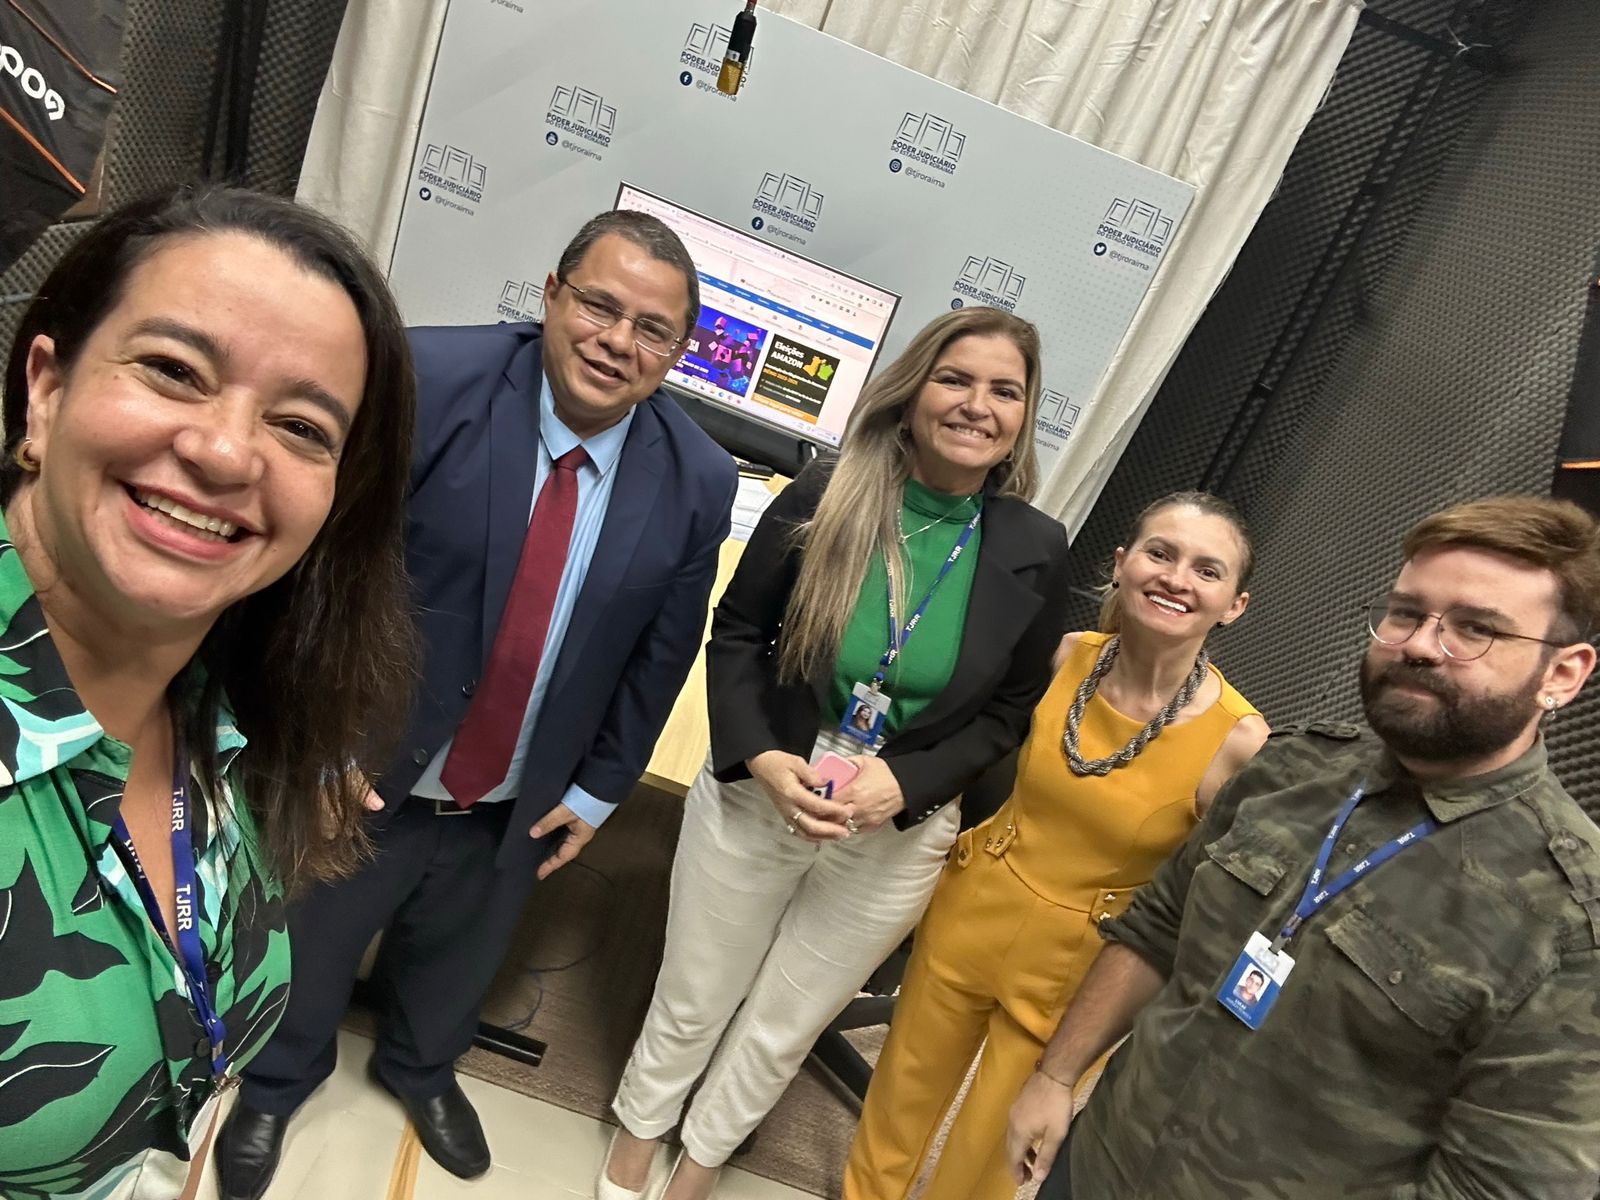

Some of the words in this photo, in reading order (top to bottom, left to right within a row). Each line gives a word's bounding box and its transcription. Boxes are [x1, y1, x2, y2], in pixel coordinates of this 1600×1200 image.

[681, 52, 706, 66] PODER
[690, 62, 710, 73] ESTADO
[547, 113, 570, 126] PODER
[572, 124, 611, 143] JUDICIÁRIO
[555, 123, 575, 133] ESTADO
[585, 135, 608, 147] RORAIMA
[562, 140, 602, 161] @tjroraima
[893, 140, 916, 153] PODER
[917, 150, 956, 170] JUDICIÁRIO
[900, 150, 920, 161] ESTADO
[929, 162, 954, 175] RORAIMA
[419, 170, 442, 182] PODER
[444, 180, 482, 199] JUDICIÁRIO
[905, 167, 945, 188] @tjroraima
[428, 179, 447, 190] ESTADO
[457, 191, 480, 203] RORAIMA
[435, 196, 474, 216] @tjroraima
[754, 199, 777, 212] PODER
[778, 209, 816, 228] JUDICIÁRIO
[762, 208, 781, 219] ESTADO
[790, 221, 813, 232] RORAIMA
[767, 225, 806, 245] @tjroraima
[1099, 225, 1122, 237] PODER
[1123, 234, 1161, 253] JUDICIÁRIO
[1106, 234, 1126, 244] ESTADO
[1134, 246, 1159, 258] RORAIMA
[1110, 250, 1149, 271] @tjroraima
[955, 281, 977, 293] PODER
[978, 291, 1015, 309] JUDICIÁRIO
[962, 290, 981, 300] ESTADO
[498, 304, 520, 316] PODER
[771, 351, 804, 369] AMAZON
[775, 341, 804, 359] Eleições
[947, 545, 963, 563] TJRR
[906, 613, 921, 632] TJRR
[172, 786, 185, 832] TJRR
[1397, 831, 1415, 845] TJRR
[1353, 859, 1370, 873] TJRR
[176, 883, 192, 931] TJRR
[1313, 890, 1329, 904] TJRR
